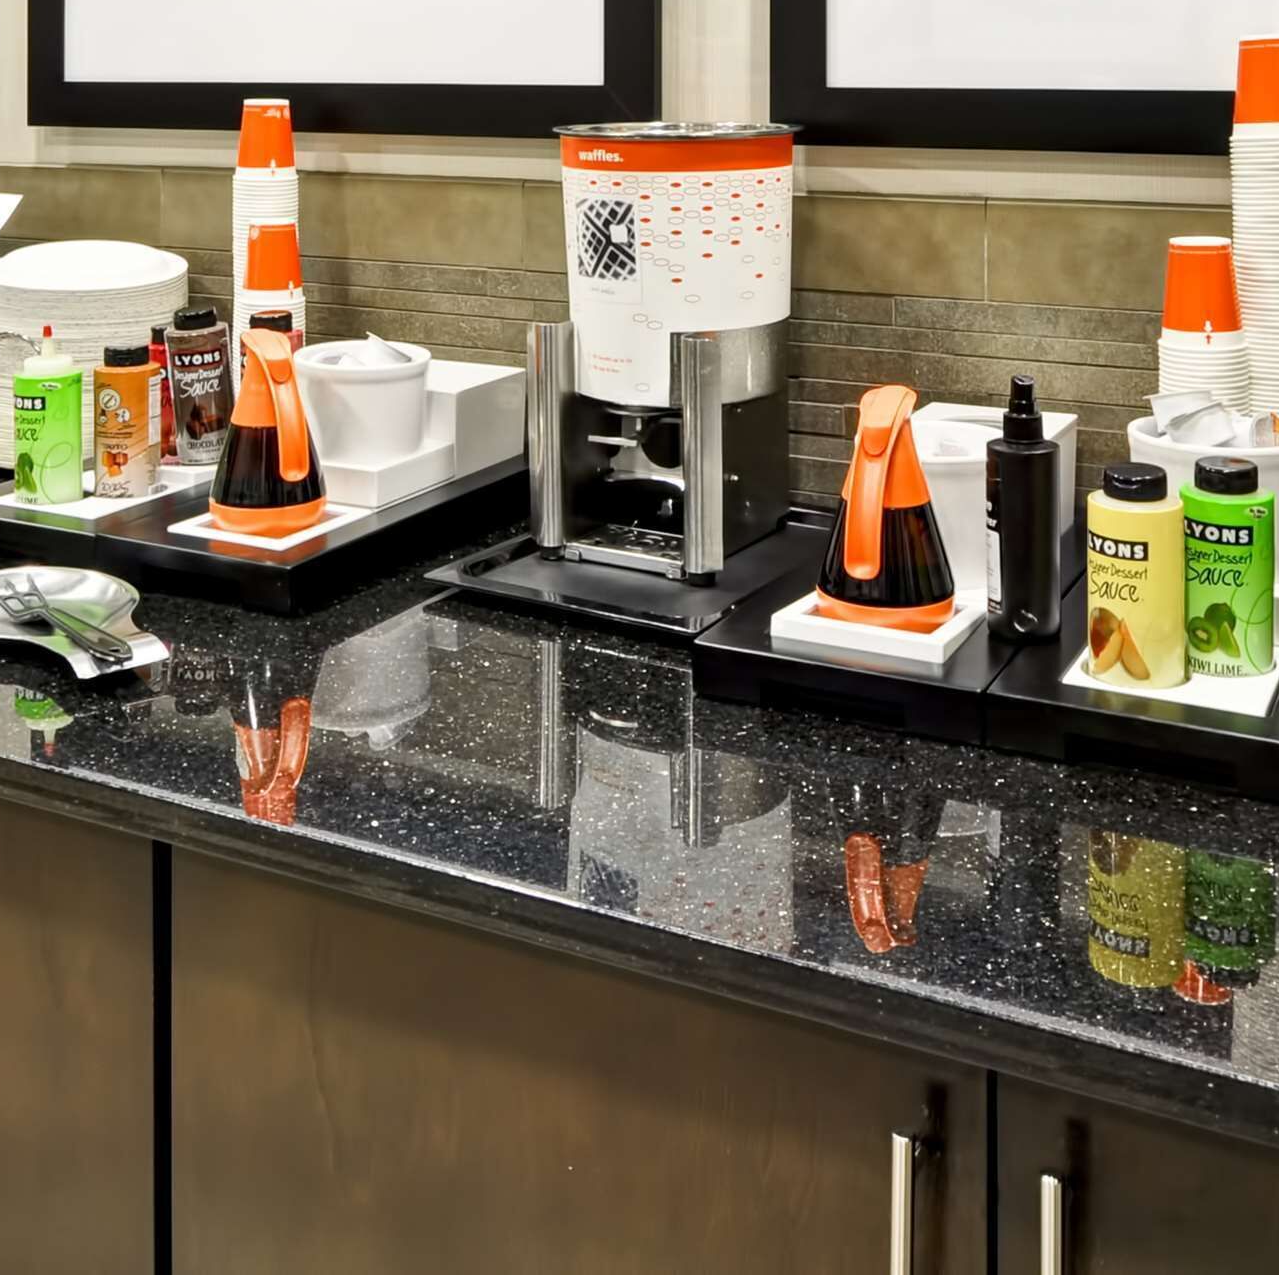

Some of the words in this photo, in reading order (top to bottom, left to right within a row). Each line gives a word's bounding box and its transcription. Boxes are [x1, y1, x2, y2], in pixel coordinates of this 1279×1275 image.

[578, 147, 625, 164] waffles.
[174, 350, 221, 367] LYONS
[15, 397, 43, 410] ONS
[186, 438, 225, 449] CHOCOLAT
[1184, 519, 1250, 545] LYONS
[1089, 533, 1145, 560] LYONS
